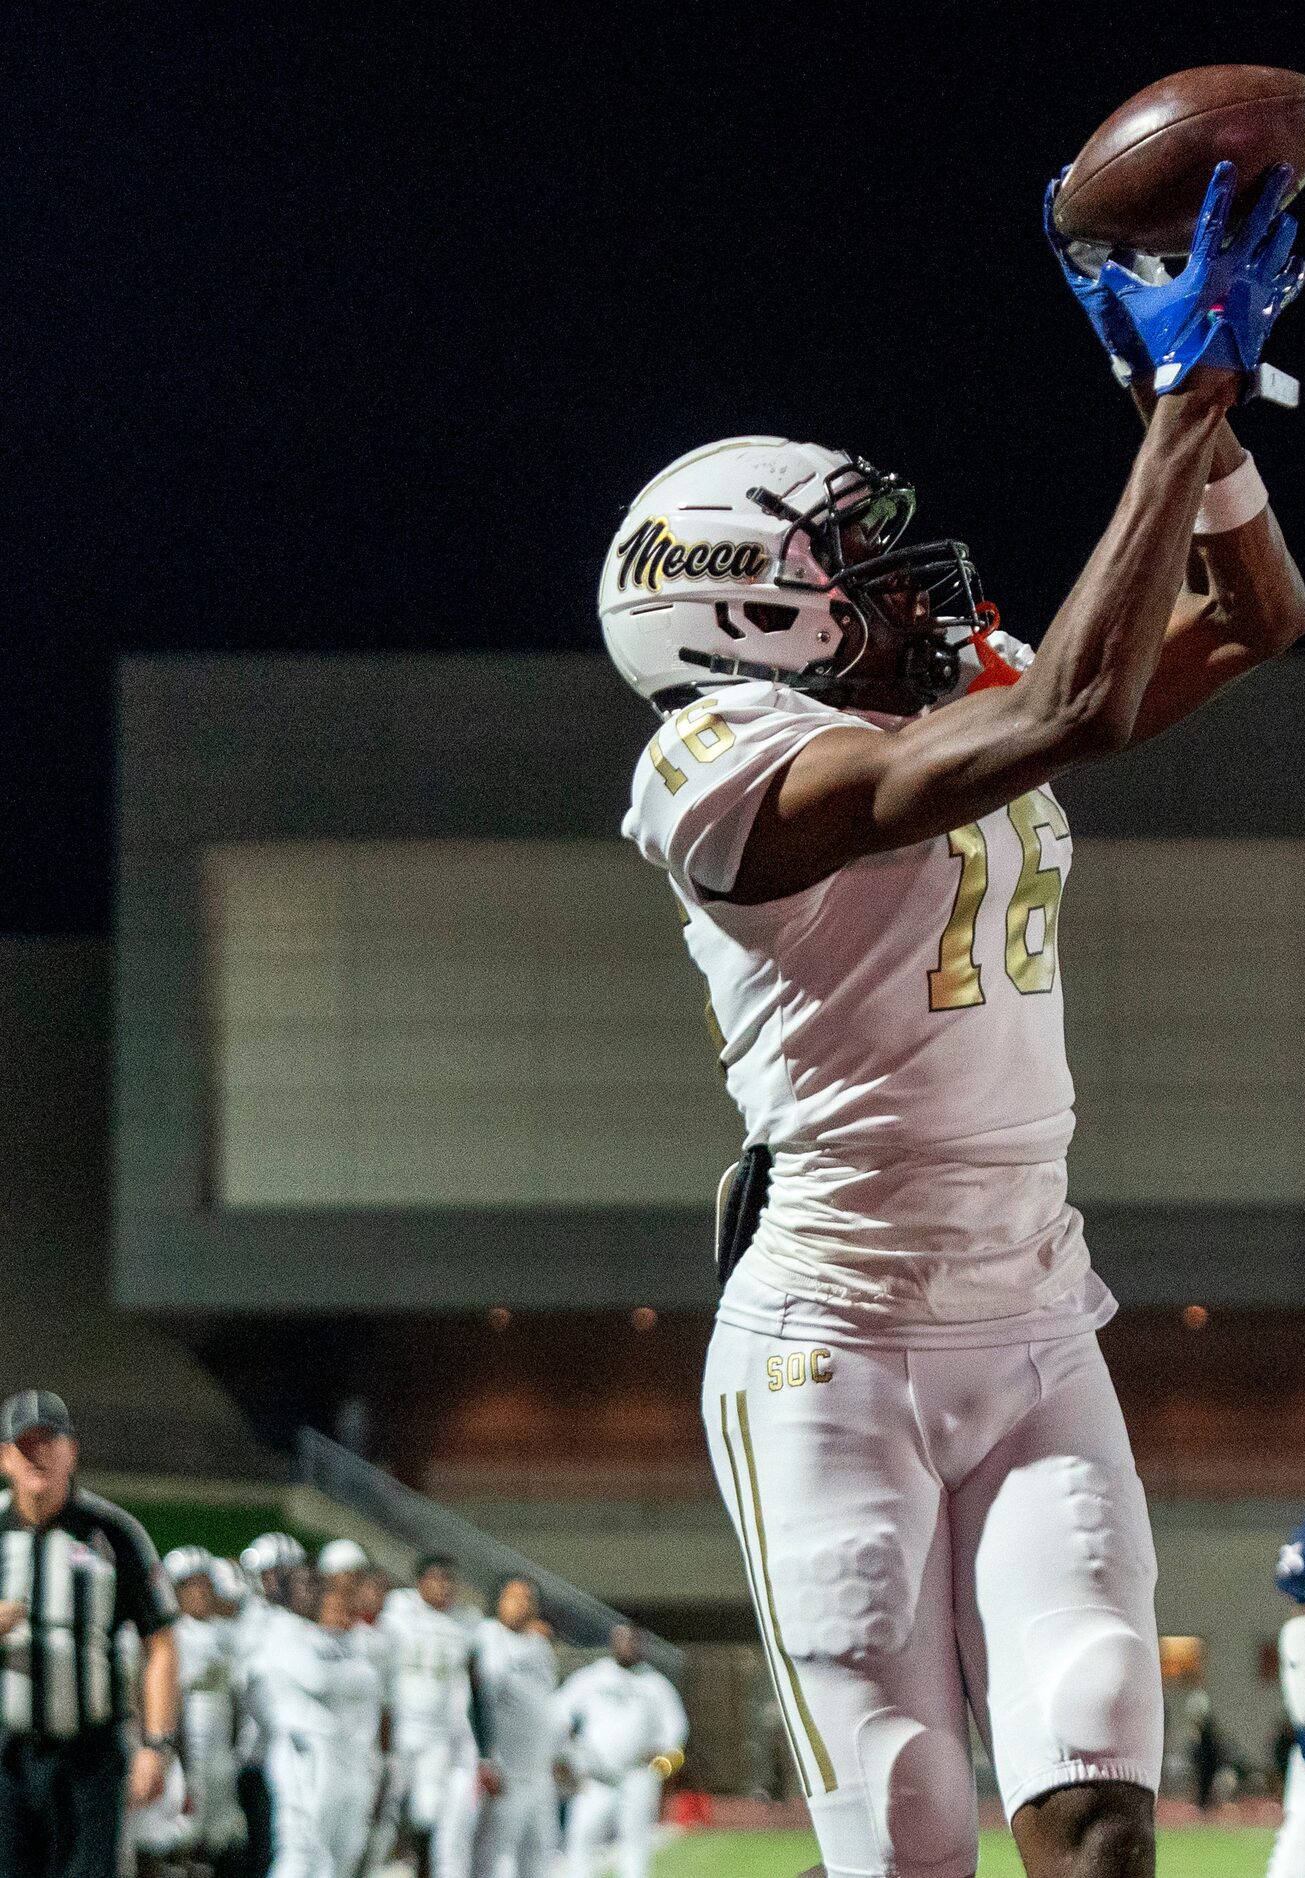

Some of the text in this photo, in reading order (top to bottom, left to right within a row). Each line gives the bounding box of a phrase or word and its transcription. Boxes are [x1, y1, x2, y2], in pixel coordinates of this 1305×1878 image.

[617, 516, 769, 594] Mecca
[648, 698, 737, 797] 16
[927, 788, 1069, 1012] 16
[766, 1348, 834, 1392] SOC
